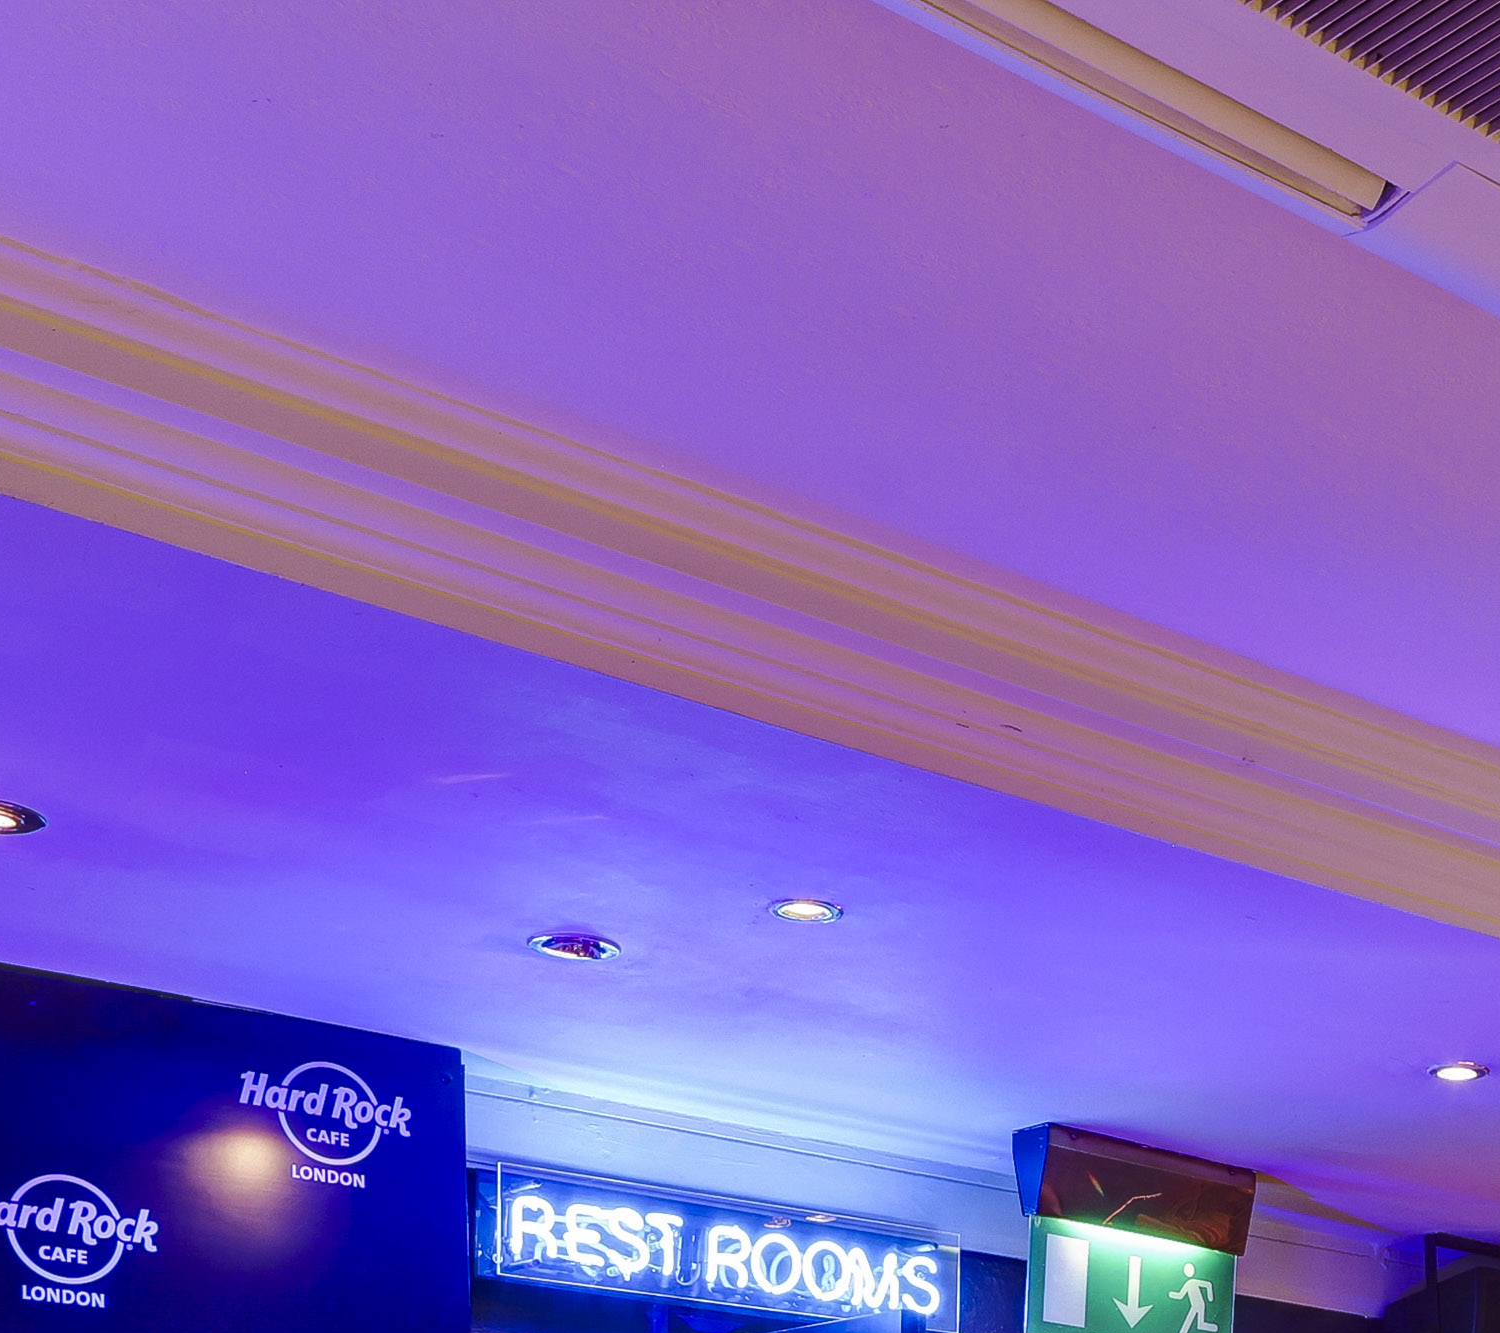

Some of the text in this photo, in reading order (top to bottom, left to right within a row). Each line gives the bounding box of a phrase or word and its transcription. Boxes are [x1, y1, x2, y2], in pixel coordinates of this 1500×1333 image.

[238, 1070, 412, 1138] Hard Rock
[305, 1126, 350, 1148] CAFE
[291, 1163, 366, 1189] LONDON
[66, 1199, 159, 1253] Rock
[38, 1244, 88, 1265] CAFE
[511, 1195, 940, 1315] REST ROOMS
[21, 1284, 105, 1309] LONDON
